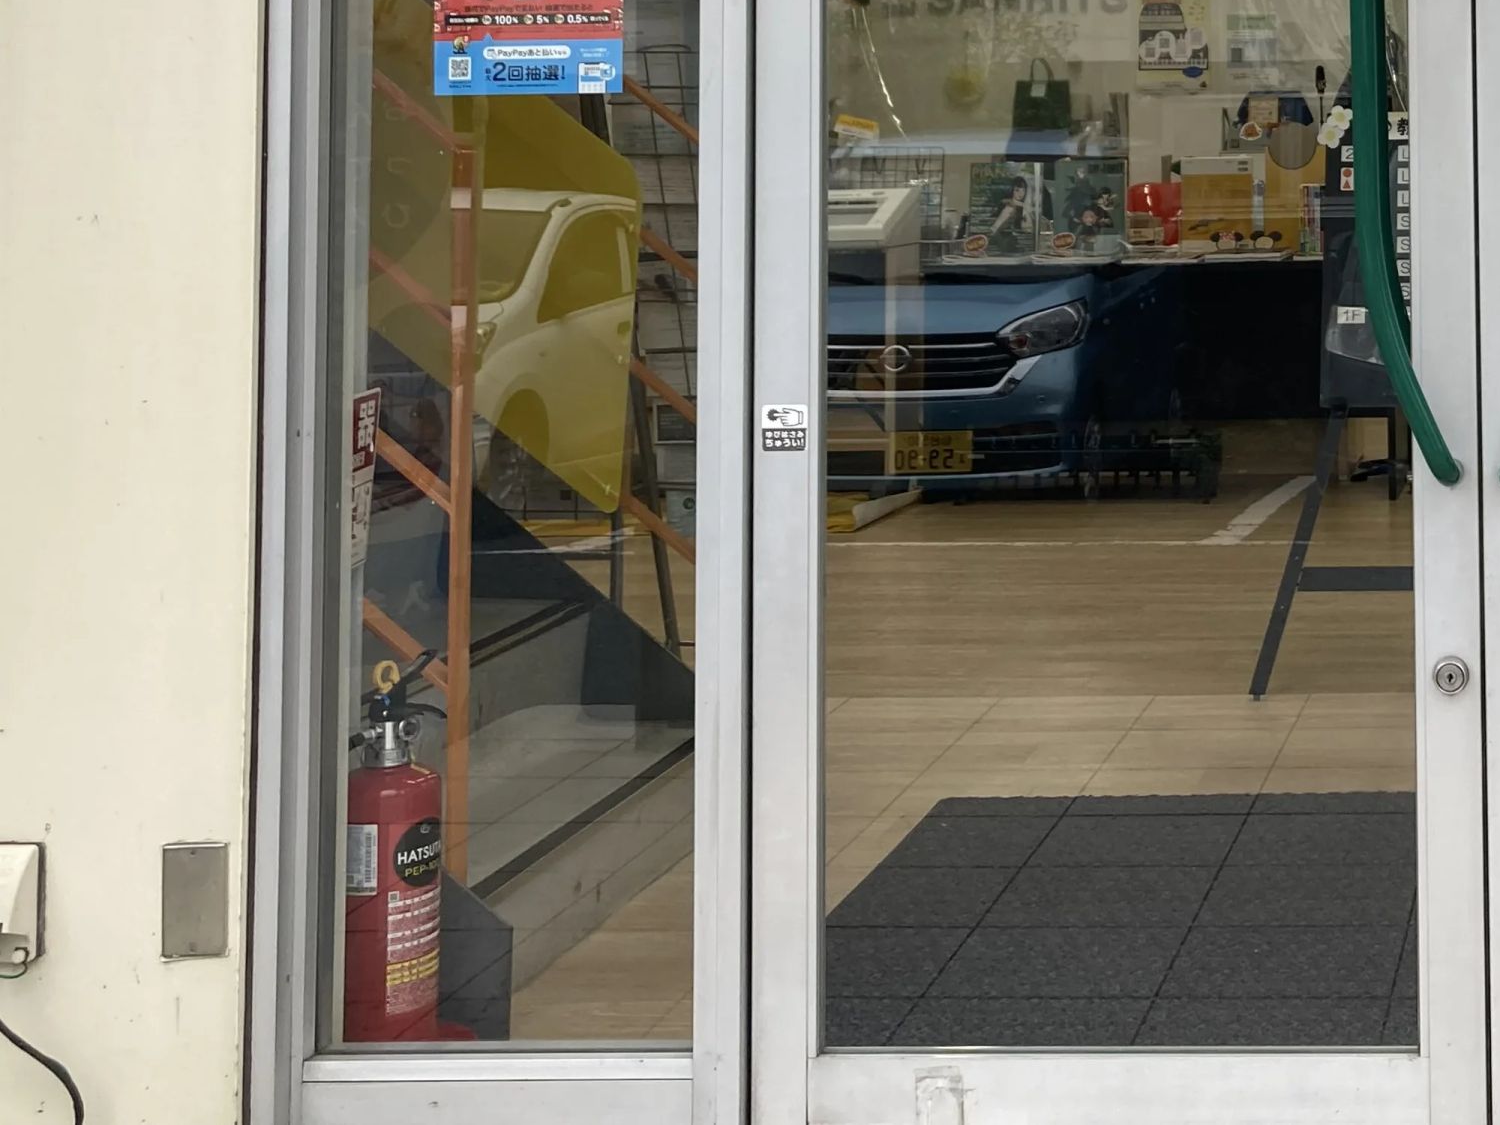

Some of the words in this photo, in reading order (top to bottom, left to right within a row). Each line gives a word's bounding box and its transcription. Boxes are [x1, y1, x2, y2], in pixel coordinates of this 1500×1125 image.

[765, 430, 805, 439] ゆびはさみ
[765, 438, 805, 448] ちゅうい!
